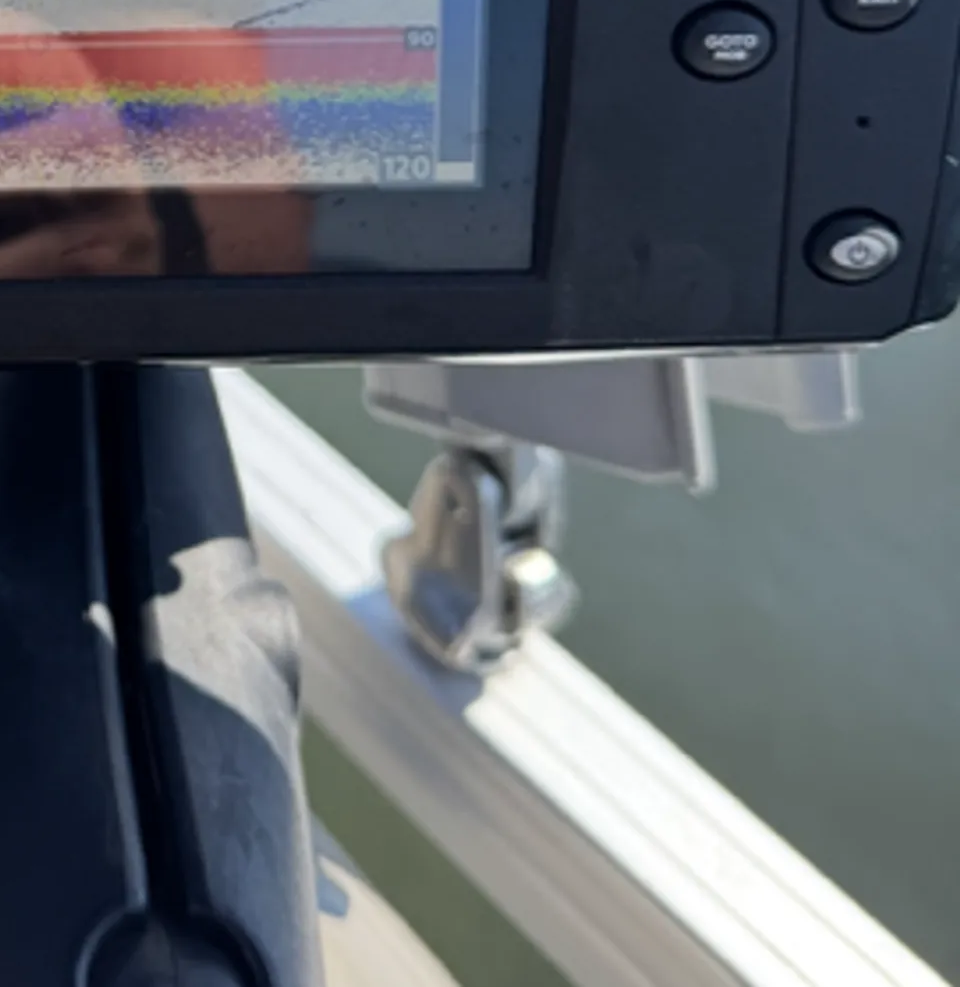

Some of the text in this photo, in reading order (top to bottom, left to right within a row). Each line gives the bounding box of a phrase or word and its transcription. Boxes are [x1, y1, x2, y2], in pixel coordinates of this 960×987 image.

[407, 31, 434, 46] 90
[704, 35, 758, 50] GOTO
[382, 154, 430, 180] 120
